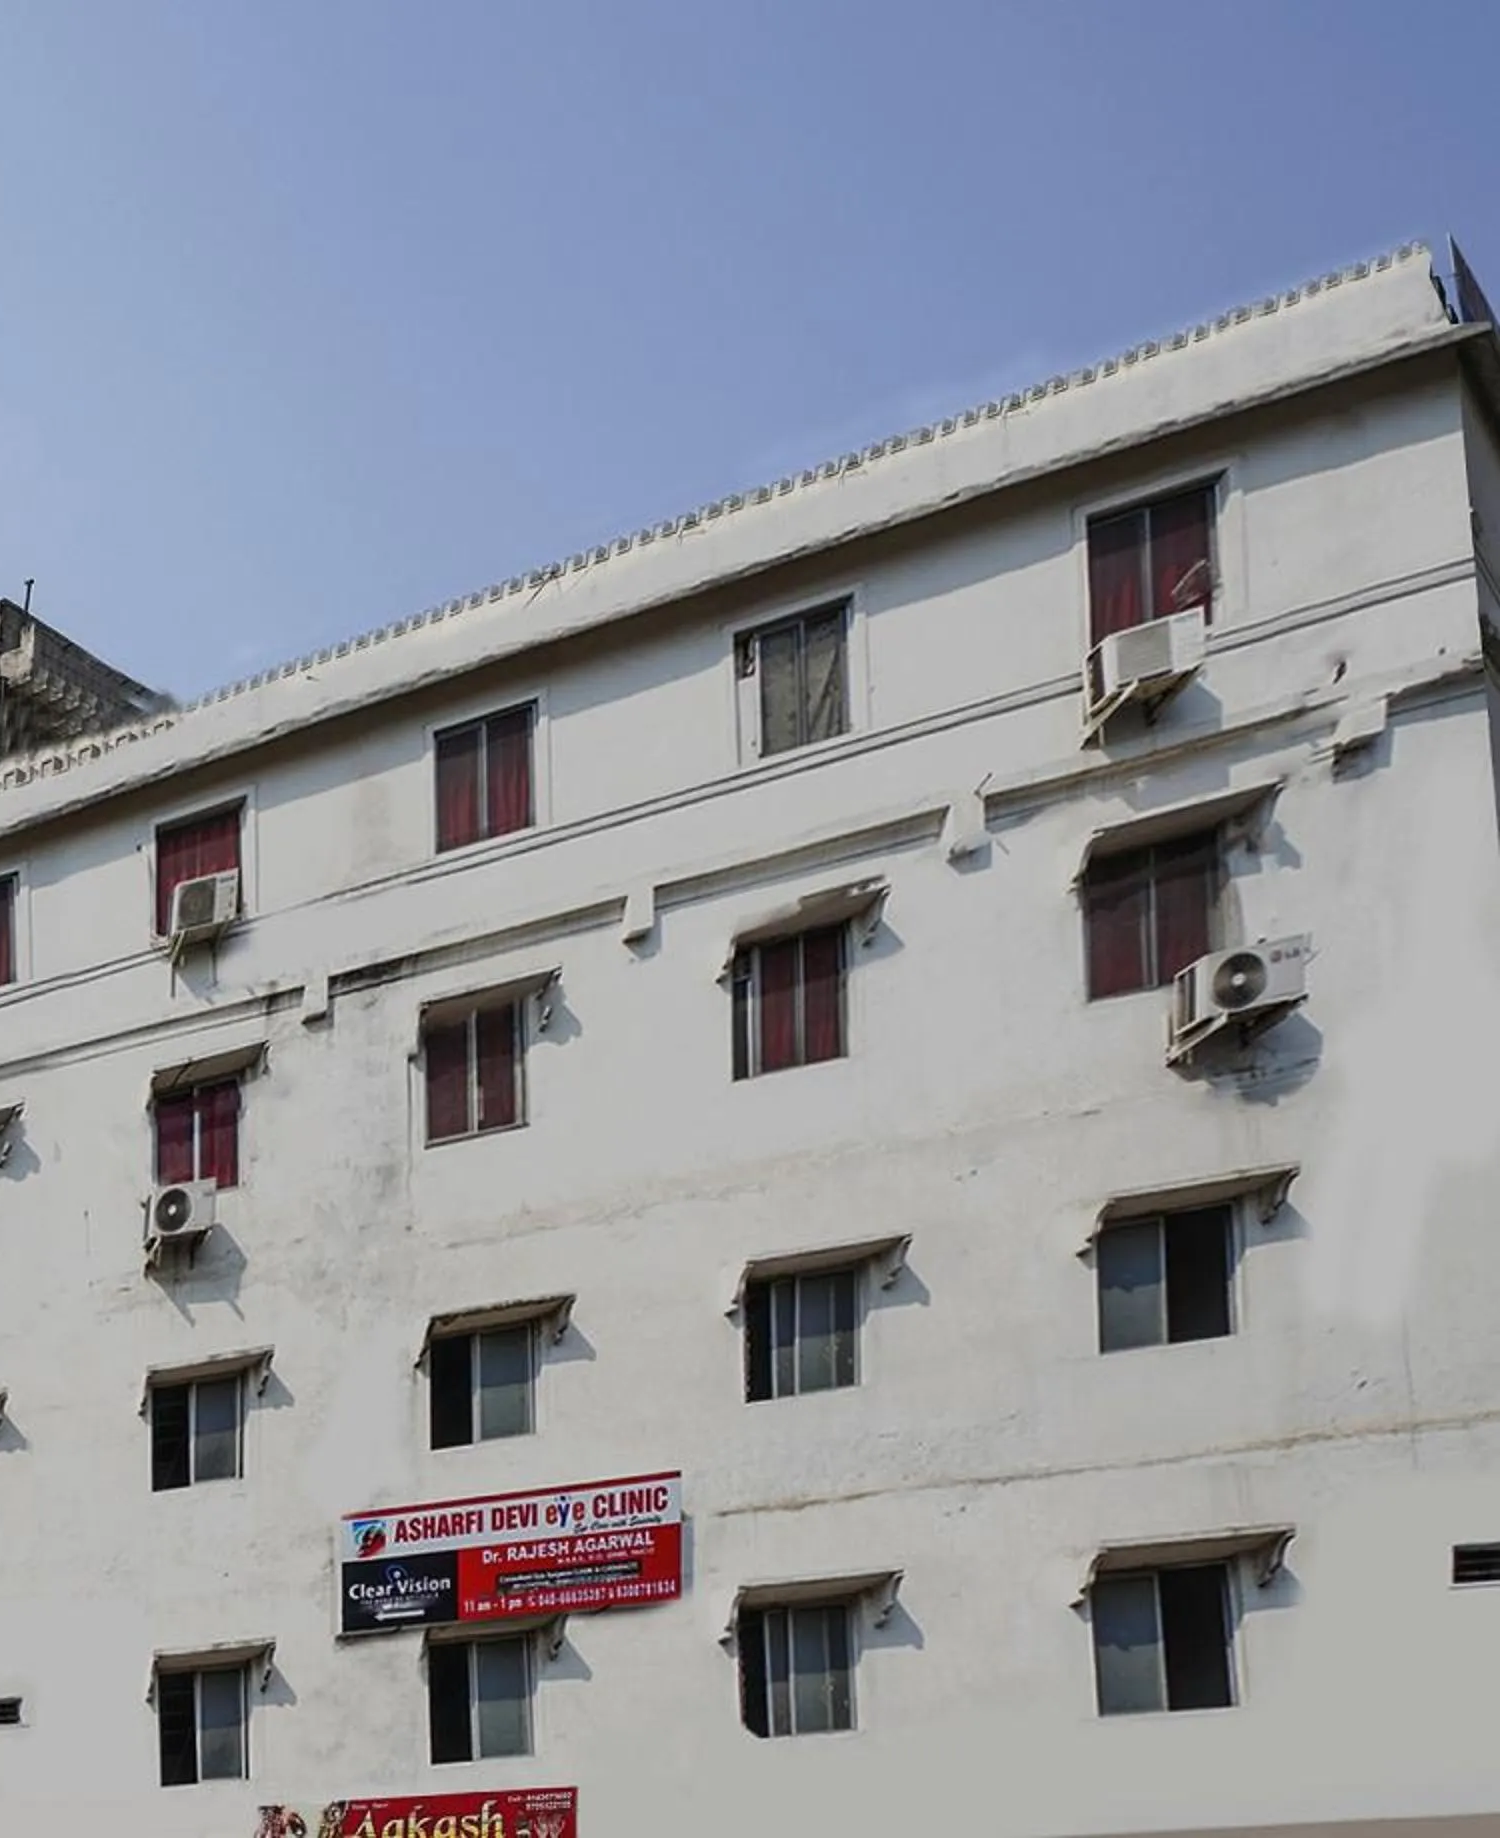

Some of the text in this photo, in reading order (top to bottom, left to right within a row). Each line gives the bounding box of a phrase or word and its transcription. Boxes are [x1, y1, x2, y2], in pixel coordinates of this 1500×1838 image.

[394, 1486, 669, 1544] ASHARFI DEVI eye CLINIC
[483, 1551, 502, 1564] Dr.
[507, 1541, 570, 1562] RAJESH
[573, 1531, 655, 1554] AGARWAL
[349, 1583, 395, 1600] Clear
[396, 1576, 452, 1595] Vision
